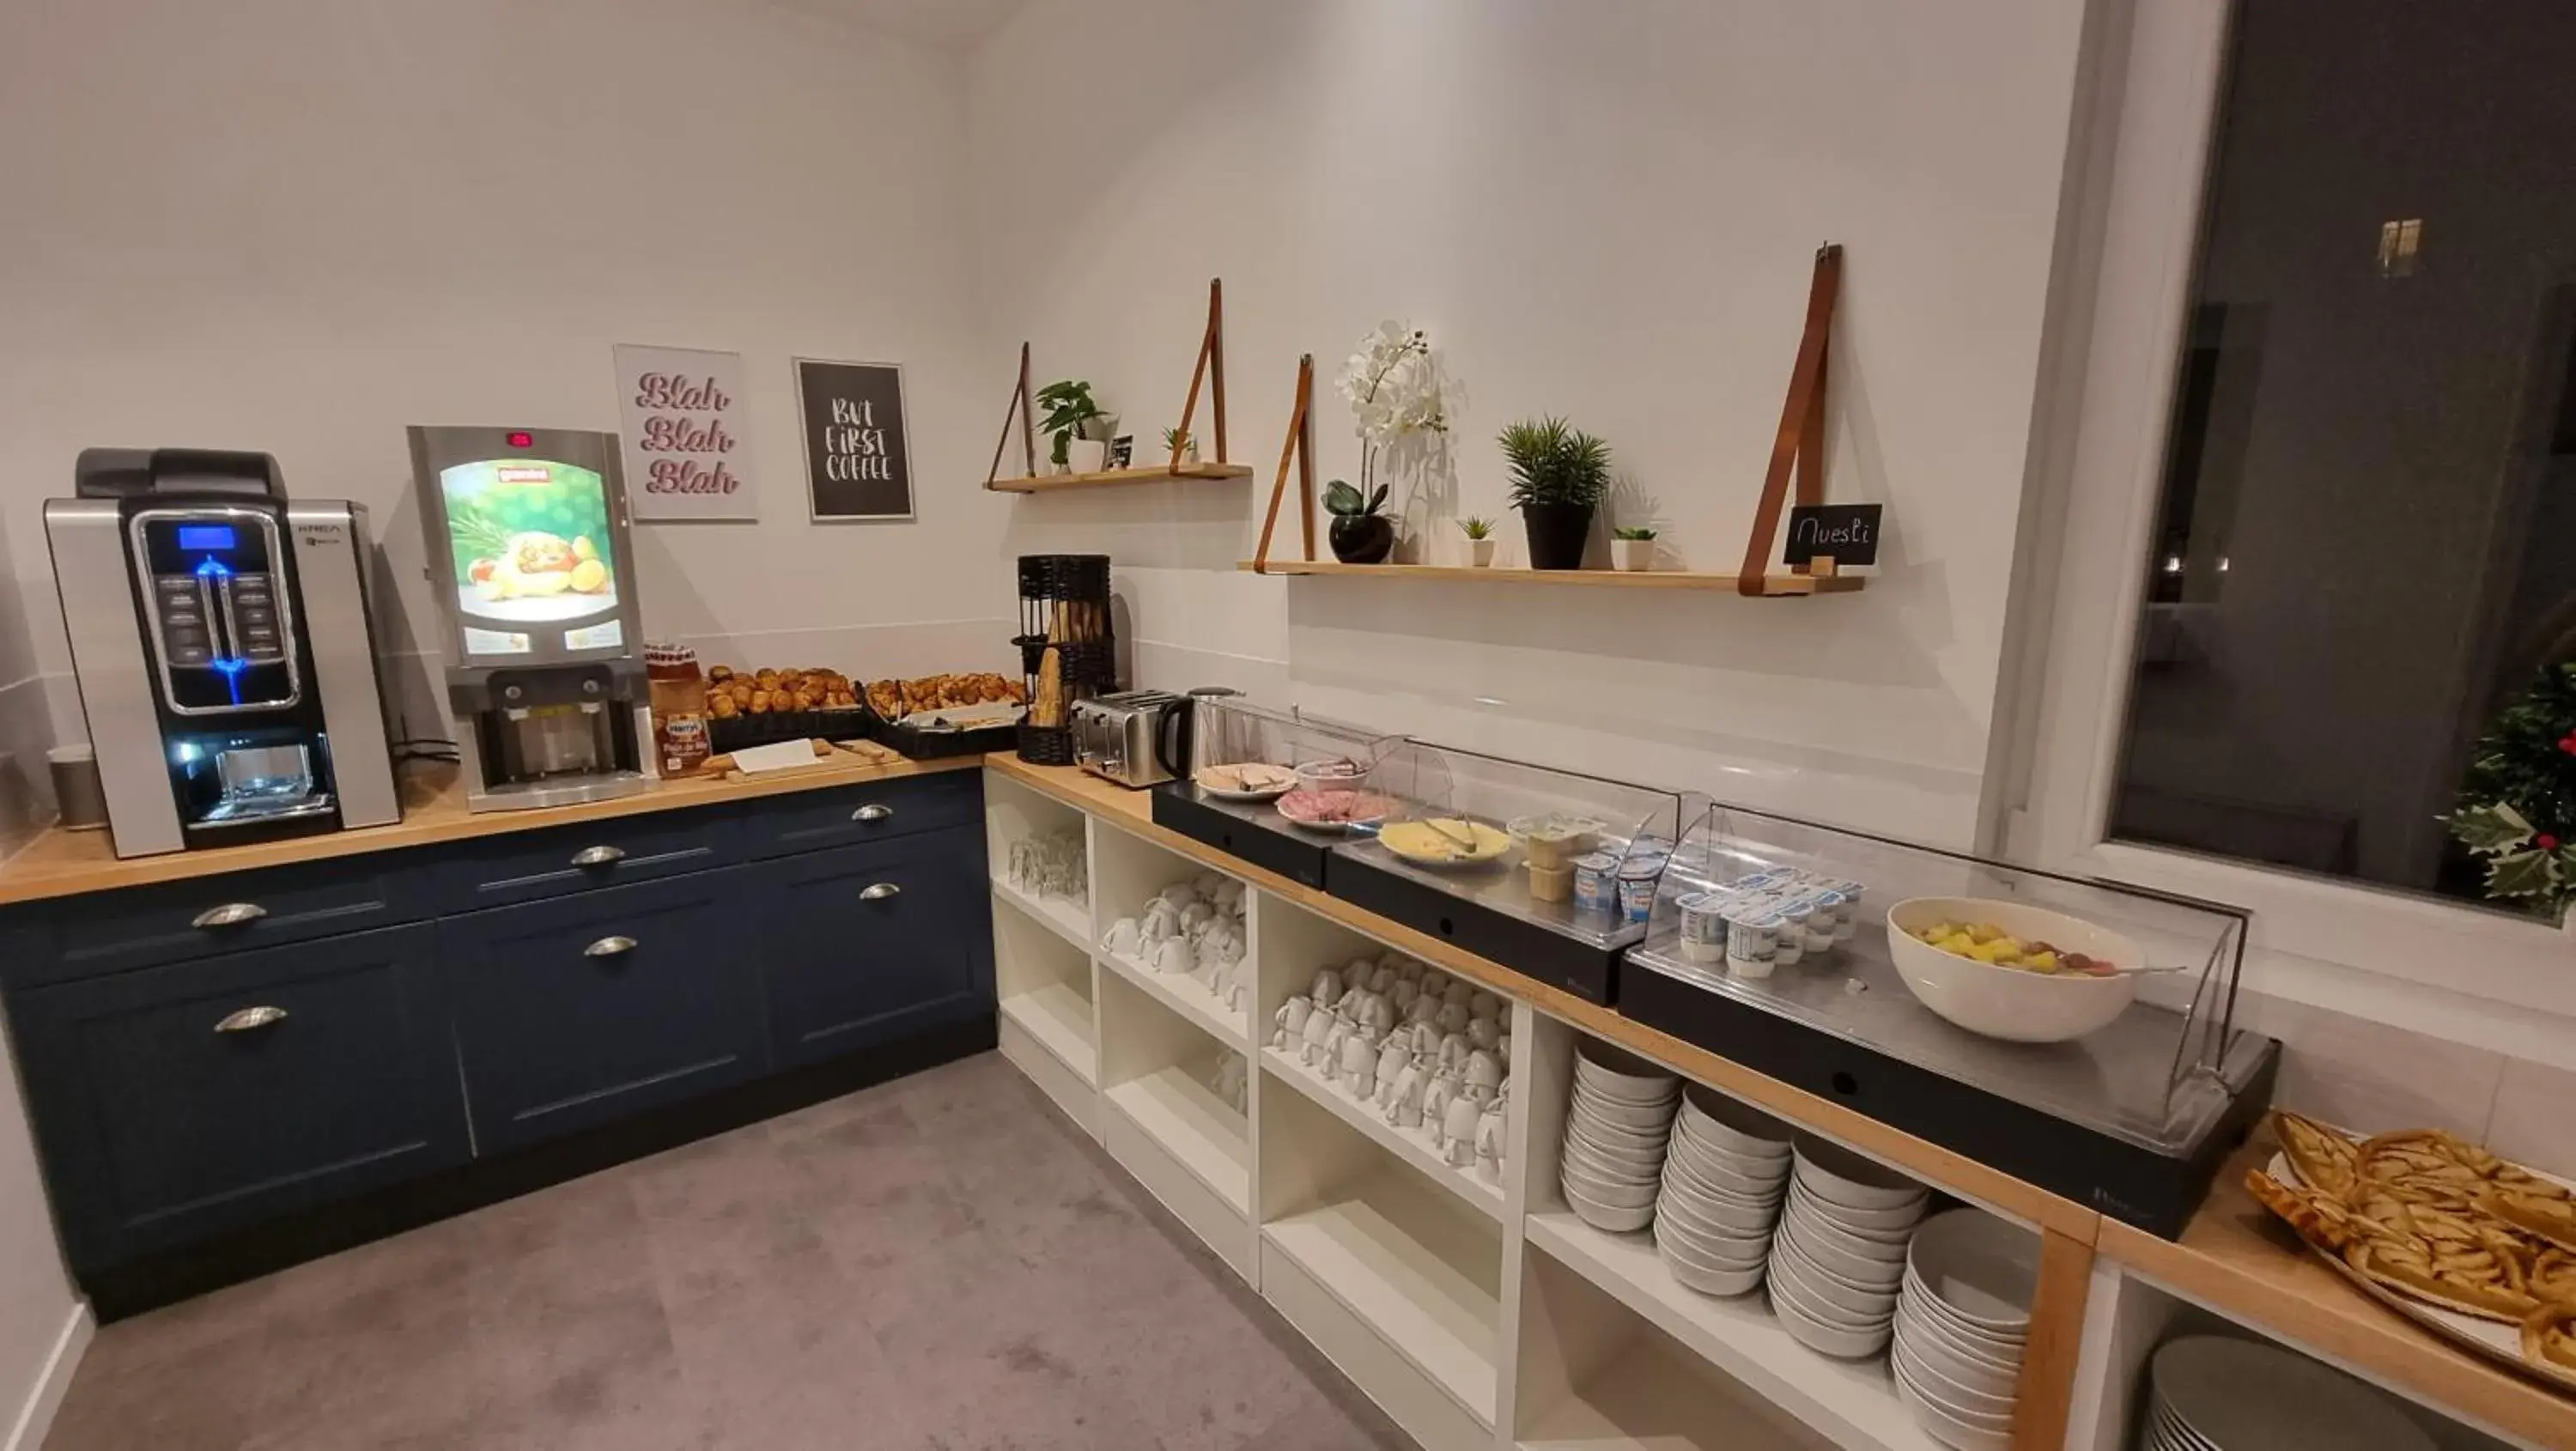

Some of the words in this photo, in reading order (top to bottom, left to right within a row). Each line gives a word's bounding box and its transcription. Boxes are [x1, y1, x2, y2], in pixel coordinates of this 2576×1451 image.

[635, 372, 732, 411] Blah
[831, 398, 873, 427] BUT
[640, 416, 737, 453] Blah
[645, 458, 741, 495] Blah
[825, 454, 894, 482] COFFEE
